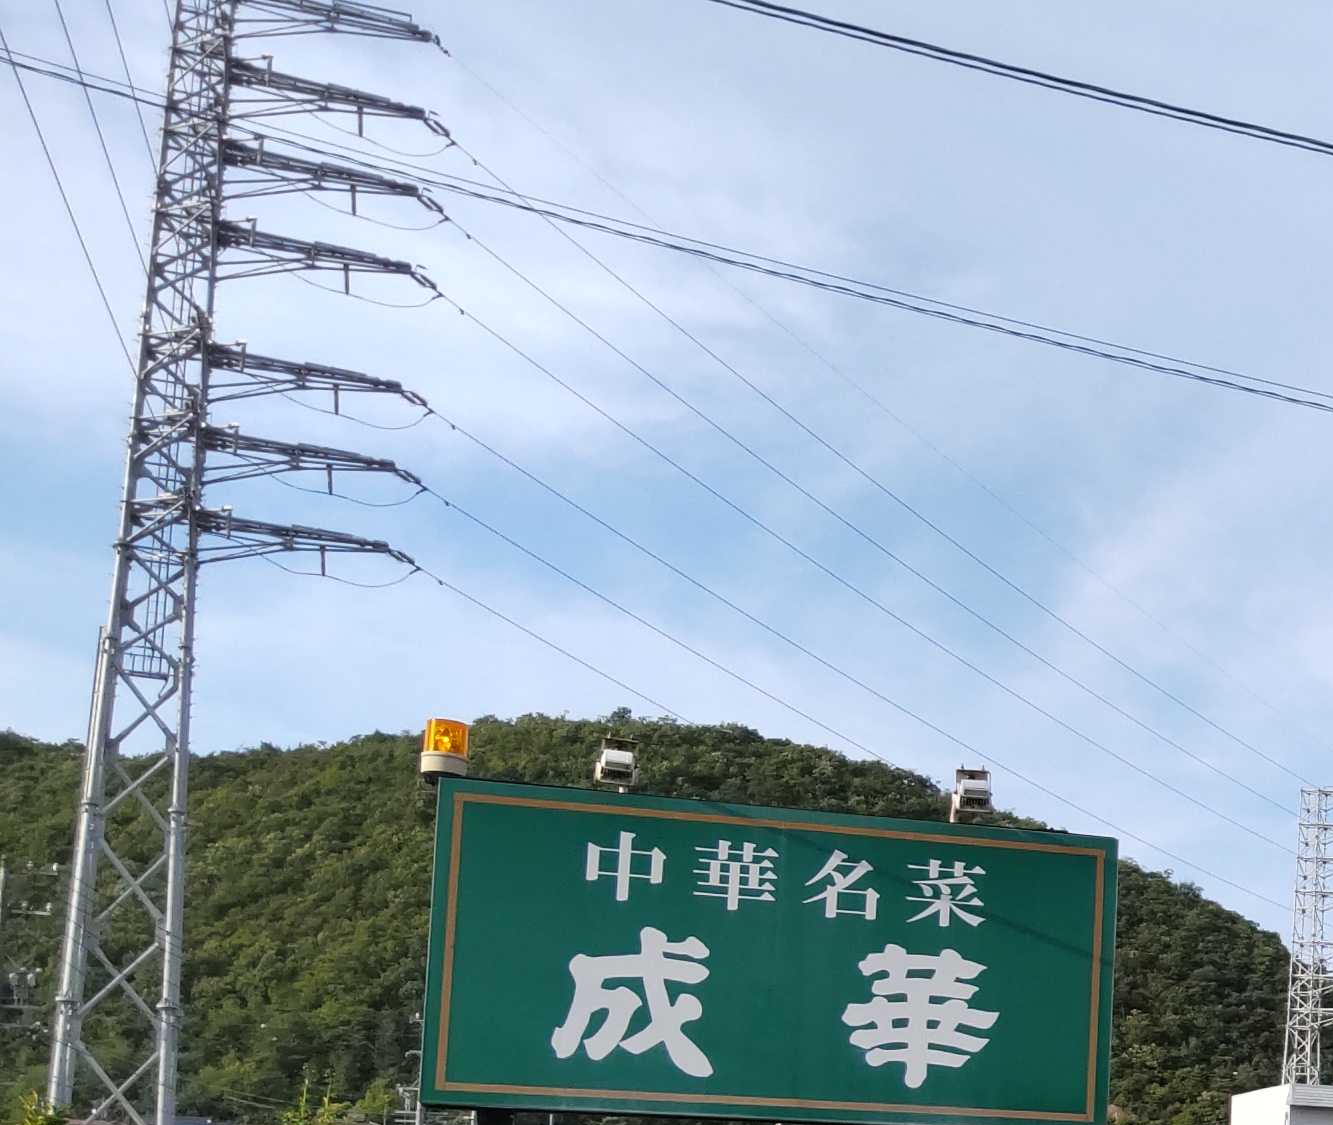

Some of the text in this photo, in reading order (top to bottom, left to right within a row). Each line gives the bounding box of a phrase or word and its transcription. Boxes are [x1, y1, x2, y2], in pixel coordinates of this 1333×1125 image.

[585, 830, 986, 927] 中華名菜
[550, 927, 1000, 1089] 成華
